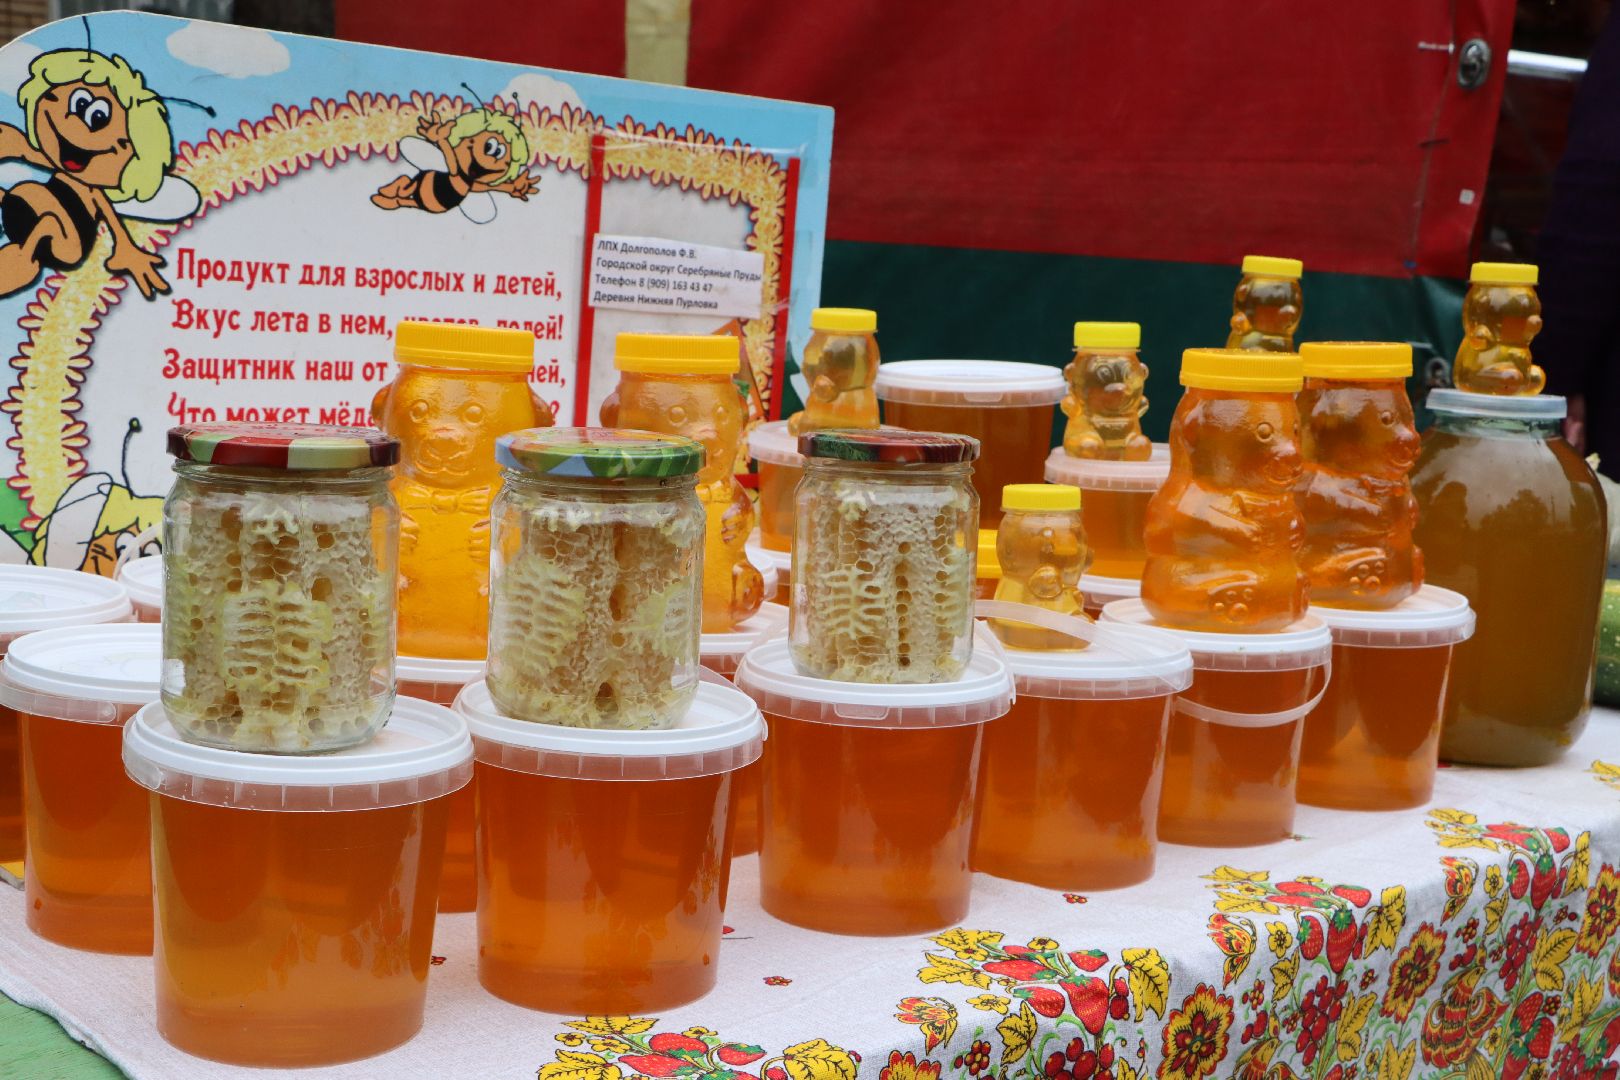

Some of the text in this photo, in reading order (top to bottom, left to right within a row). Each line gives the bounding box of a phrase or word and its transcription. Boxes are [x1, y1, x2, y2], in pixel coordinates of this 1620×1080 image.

[598, 240, 618, 252] ЛПХ
[620, 243, 677, 257] Долгополов
[177, 247, 562, 299] Продукт для взрослых и детей,
[595, 274, 713, 293] Телефон 8 (909) 163 43 47
[596, 257, 762, 282] Городской округ Серебряные Пруды
[594, 291, 718, 310] Деревня Нижняя Пурловка
[171, 298, 241, 338] Вкус
[251, 311, 308, 334] лета
[318, 314, 332, 335] в
[340, 314, 393, 338] нем,
[162, 348, 388, 385] Защитник наш от
[167, 391, 217, 425] Что
[226, 406, 309, 426] может
